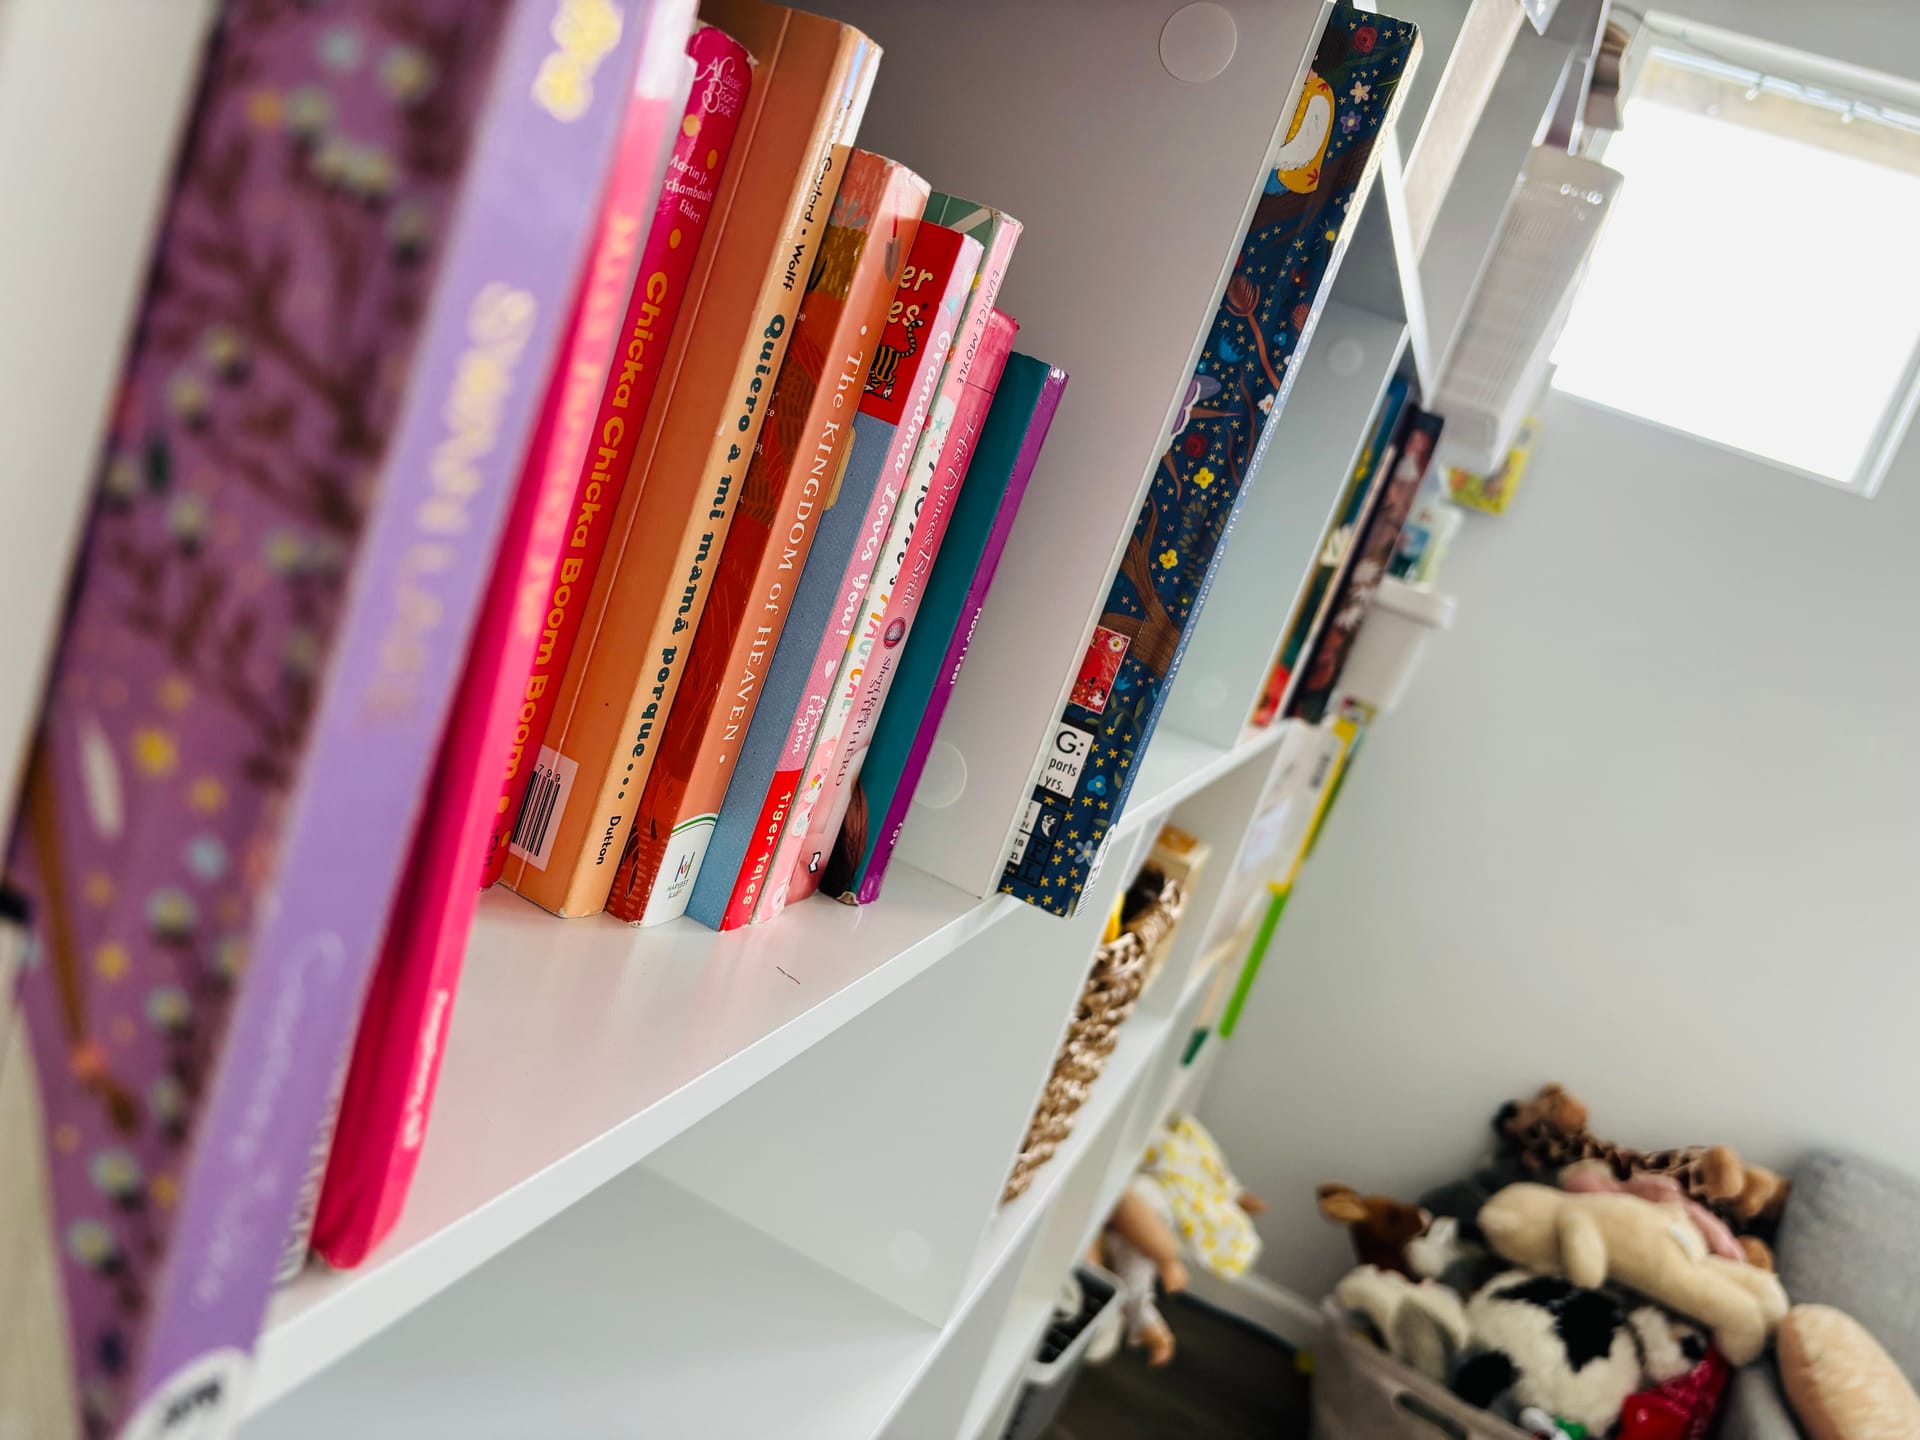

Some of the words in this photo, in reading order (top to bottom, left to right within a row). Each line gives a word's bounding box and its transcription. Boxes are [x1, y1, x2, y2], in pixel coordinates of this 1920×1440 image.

[665, 179, 713, 203] chambault
[679, 198, 701, 224] Ehlert
[783, 244, 805, 291] Wolff
[977, 269, 1000, 325] EUNICE
[613, 271, 668, 409] Chicka
[957, 332, 979, 385] MOYLE
[739, 314, 785, 432] Quiero
[832, 352, 863, 408] The
[895, 331, 951, 476] Grandma
[728, 443, 741, 463] a
[954, 413, 978, 466] His
[570, 416, 625, 548] Chicka
[709, 475, 732, 521] mi
[778, 420, 840, 569] KINGDOM
[924, 467, 962, 544] Princess
[862, 482, 896, 561] Loves
[765, 583, 782, 615] of
[902, 547, 932, 608] Bride
[535, 558, 584, 666] Boom
[723, 626, 772, 740] HEAVEN
[869, 656, 891, 693] Sheri
[502, 674, 548, 781] Boom
[792, 695, 821, 755] Edgson
[836, 679, 874, 786] SHEPHERD
[539, 764, 561, 784] 799
[1043, 775, 1064, 793] yrs.
[1048, 757, 1077, 777] parts
[596, 815, 622, 866] Dutton
[766, 791, 791, 846] tiger
[743, 852, 769, 905] tales
